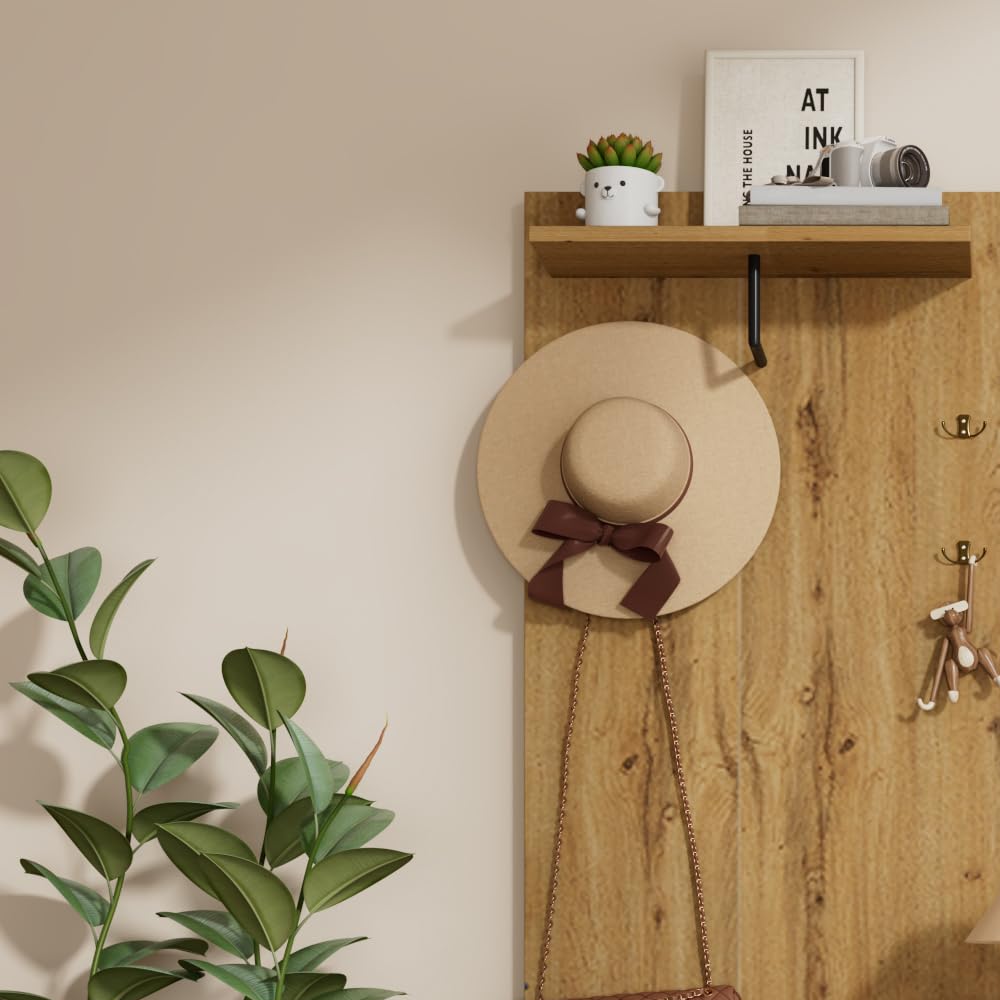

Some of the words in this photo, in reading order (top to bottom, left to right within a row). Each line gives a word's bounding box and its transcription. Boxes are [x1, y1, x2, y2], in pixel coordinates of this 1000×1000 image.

[801, 88, 829, 111] AT
[742, 129, 753, 164] HOUSE
[805, 126, 843, 150] INK
[742, 168, 753, 188] THE
